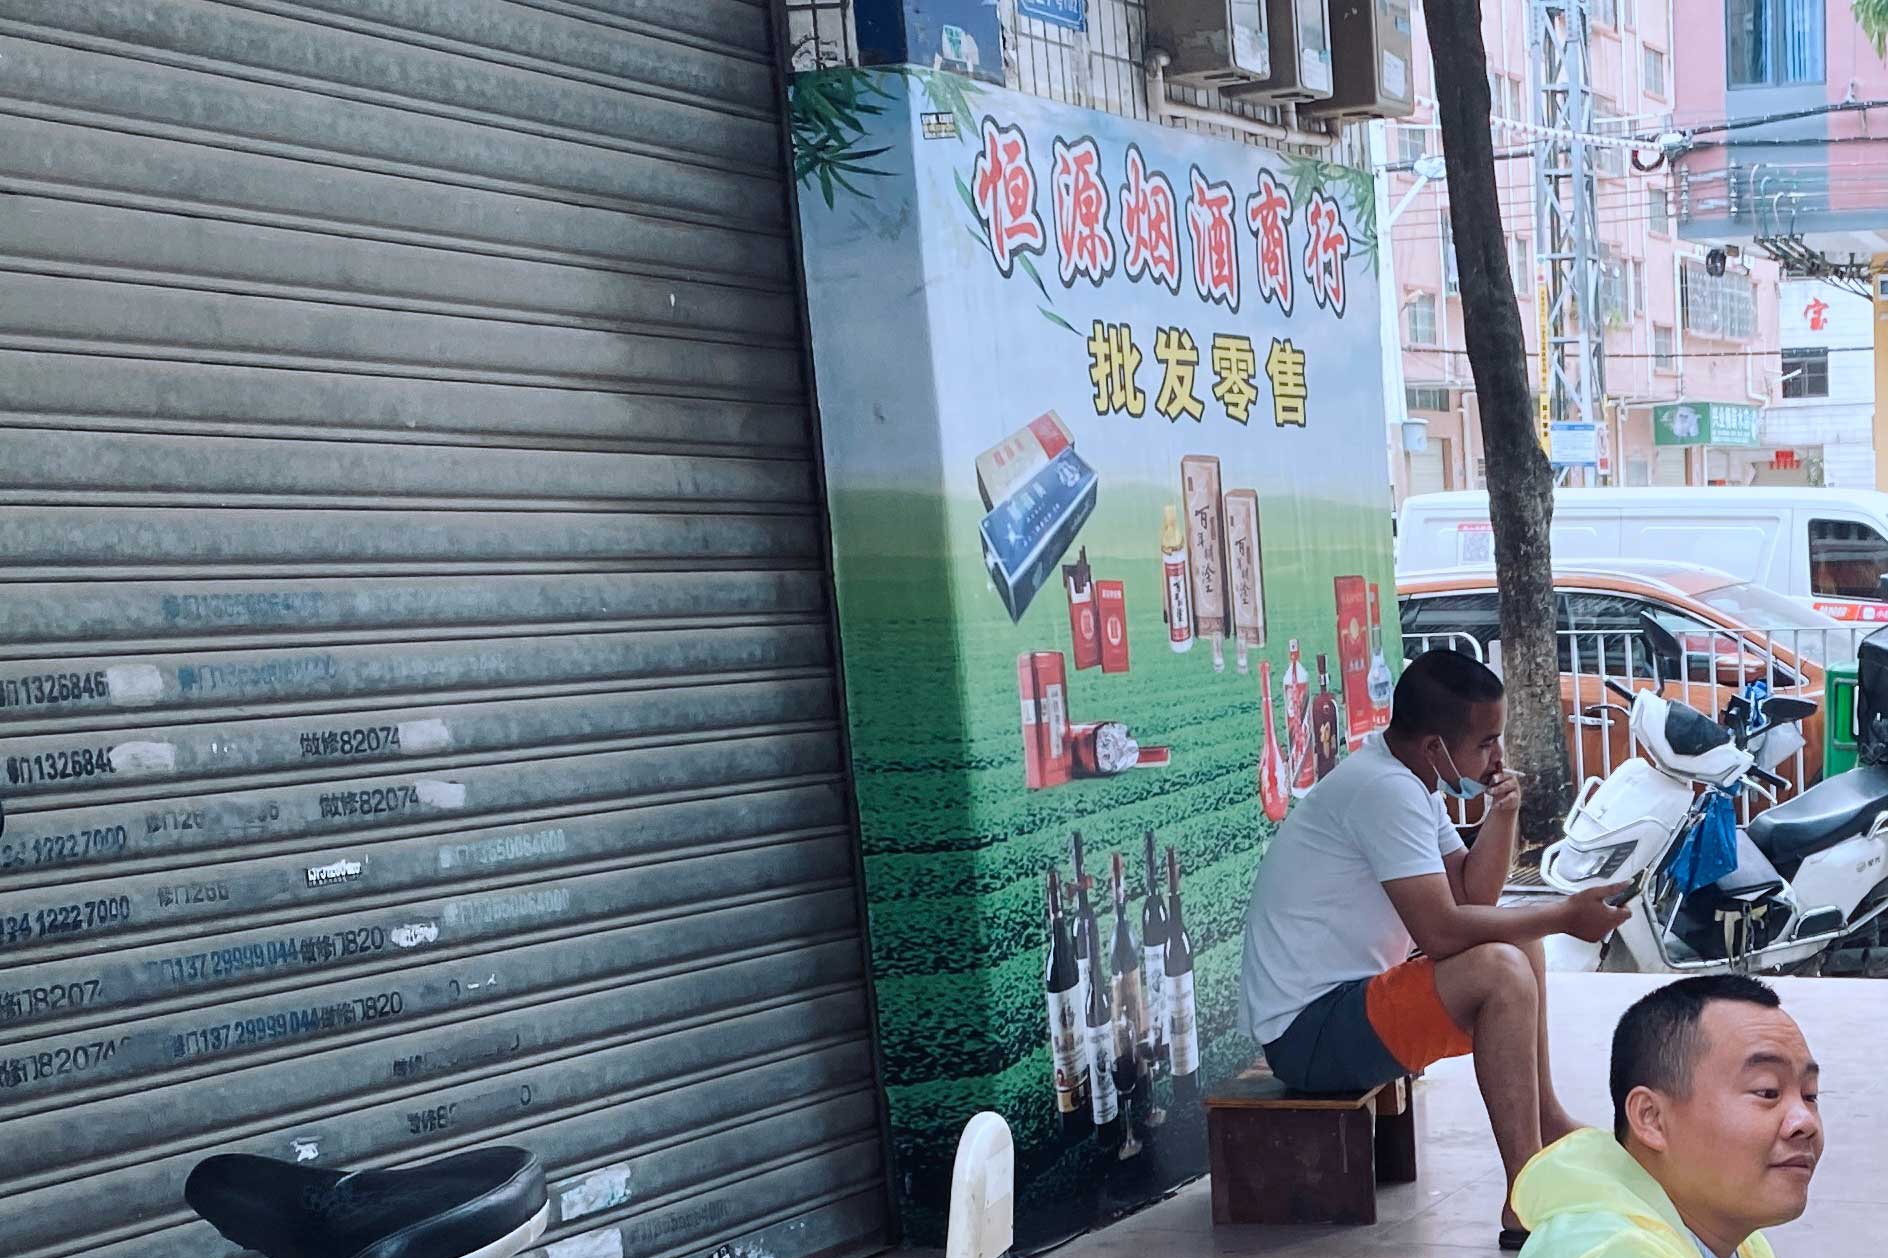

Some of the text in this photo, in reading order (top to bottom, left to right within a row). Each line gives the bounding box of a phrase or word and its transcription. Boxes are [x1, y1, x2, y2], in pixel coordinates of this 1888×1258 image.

[972, 115, 1351, 317] 恒源烟酒商行
[1088, 320, 1308, 428] 批发零售
